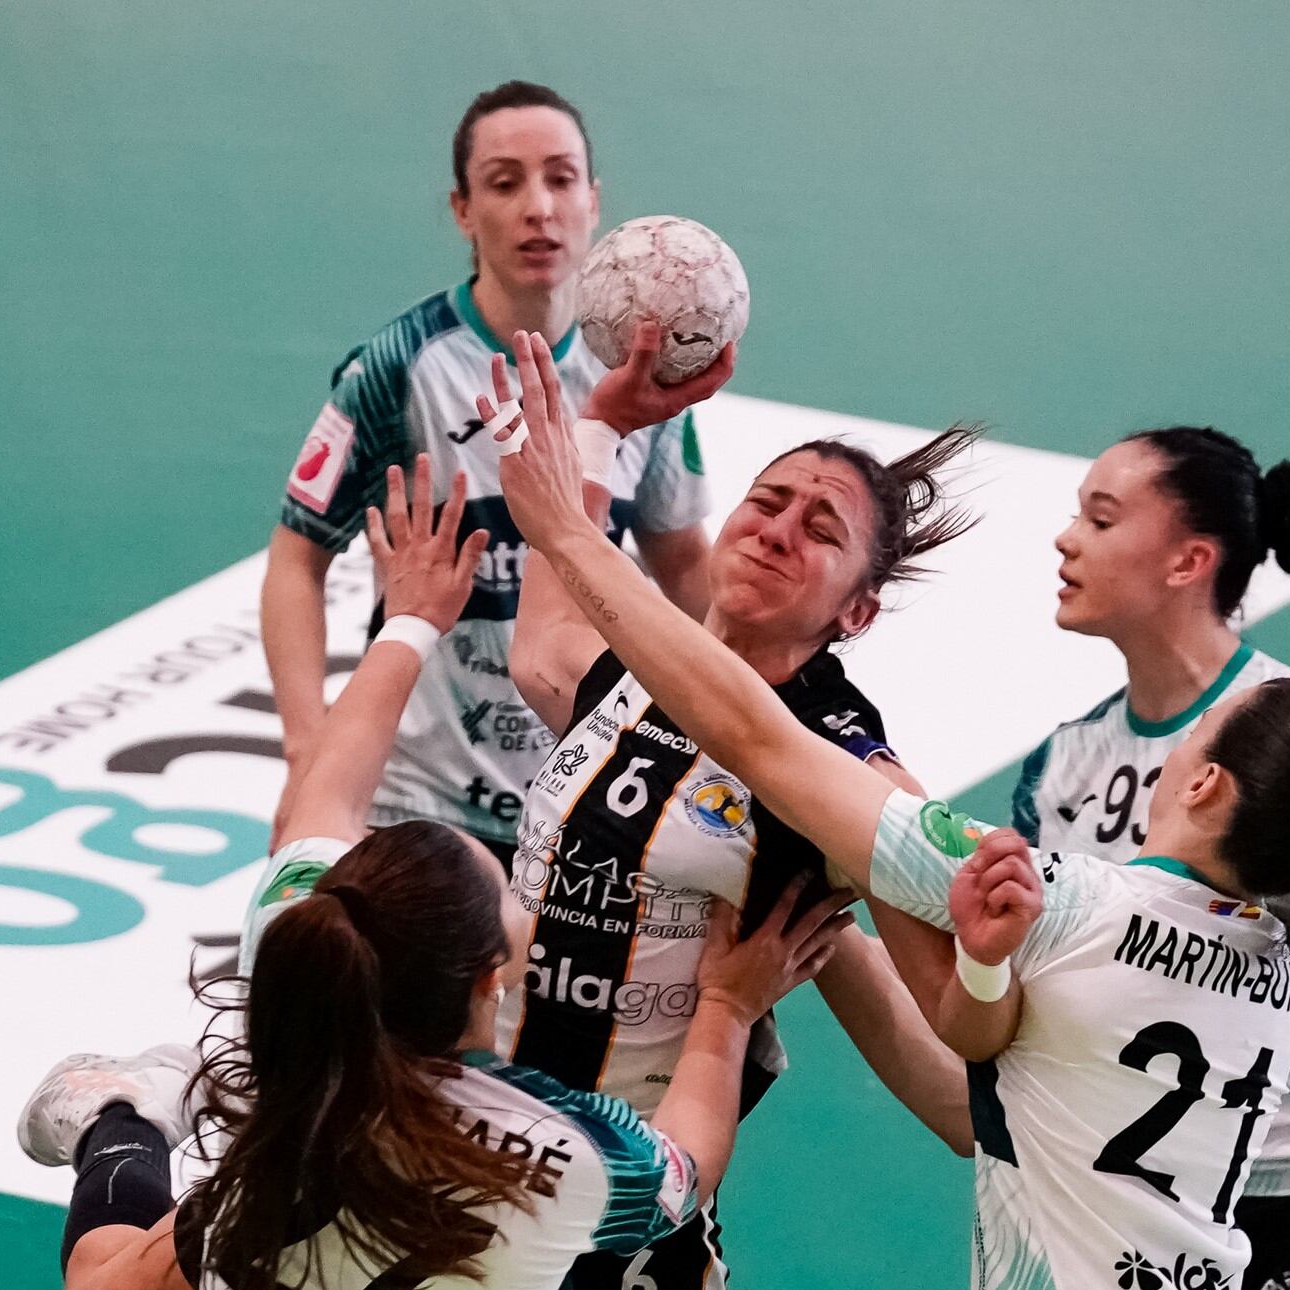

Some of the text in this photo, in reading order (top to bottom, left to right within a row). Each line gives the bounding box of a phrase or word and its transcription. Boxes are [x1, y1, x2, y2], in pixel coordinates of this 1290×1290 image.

[466, 776, 524, 823] te
[606, 756, 656, 819] 6
[602, 917, 630, 935] EN
[635, 922, 707, 940] FORMA
[524, 943, 698, 1027] álaga
[1093, 1020, 1275, 1225] 21
